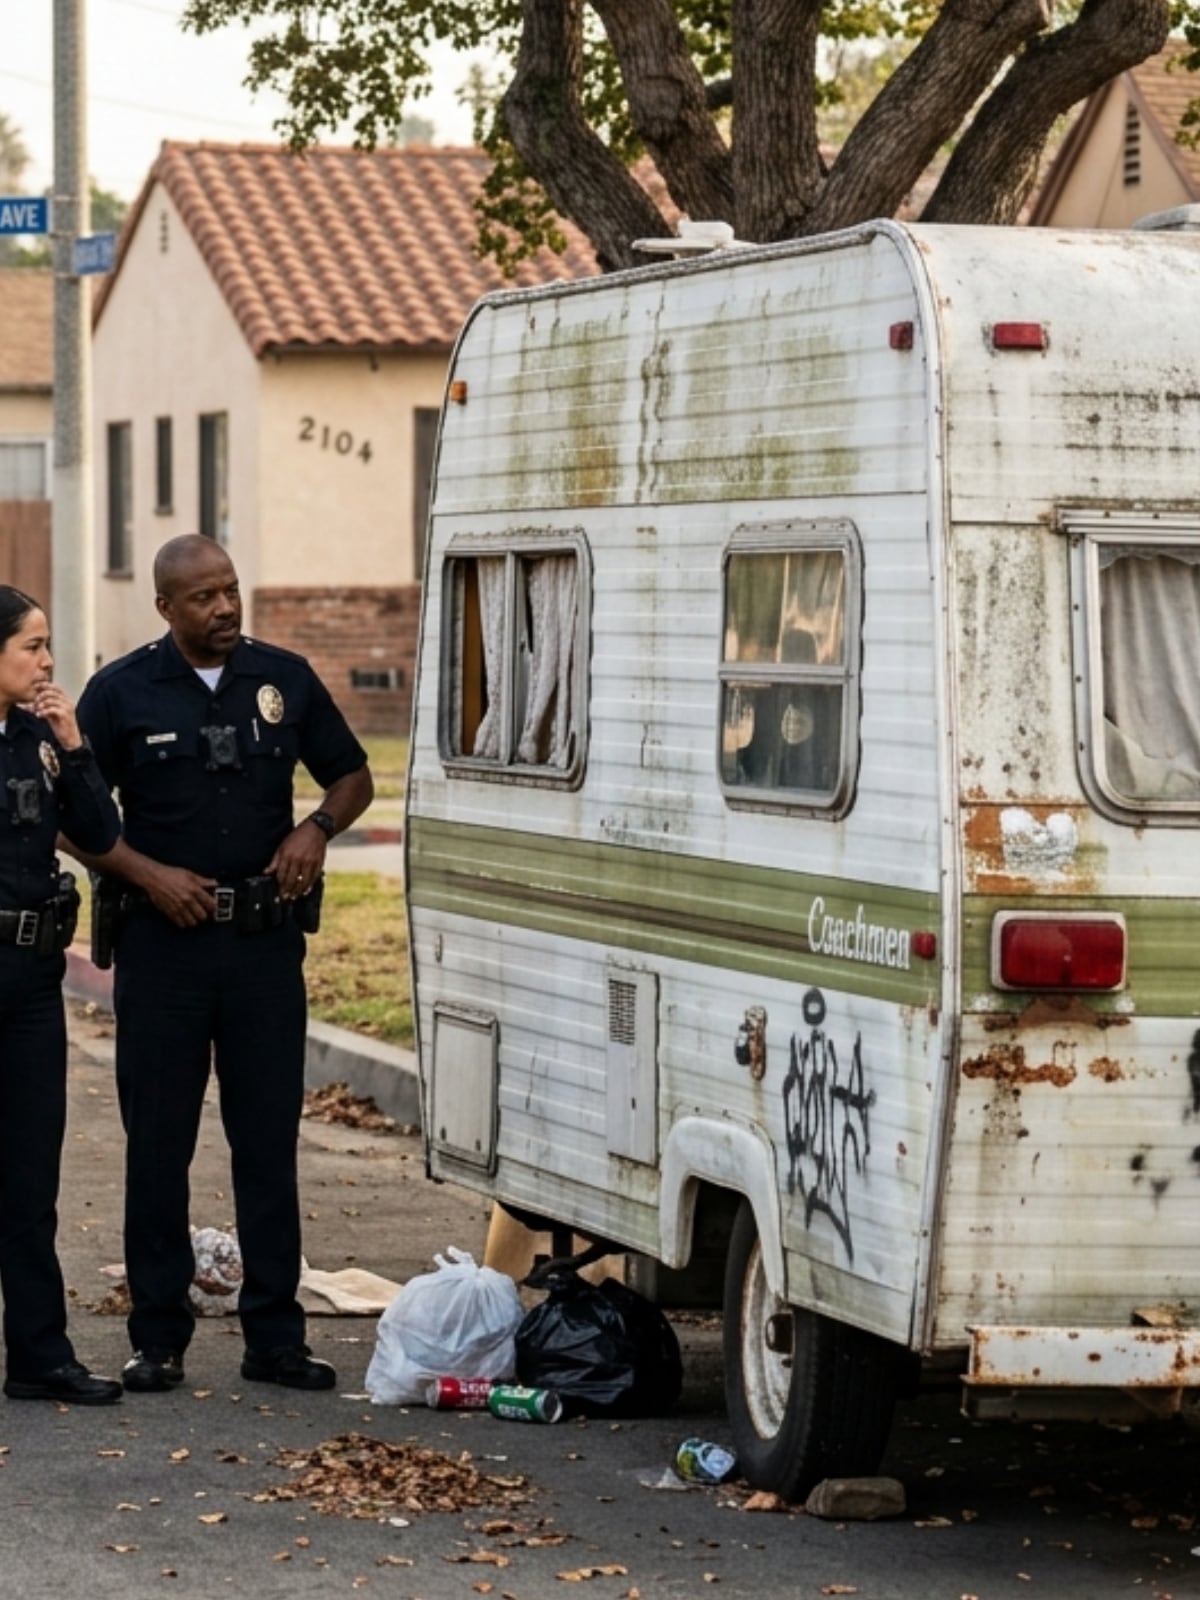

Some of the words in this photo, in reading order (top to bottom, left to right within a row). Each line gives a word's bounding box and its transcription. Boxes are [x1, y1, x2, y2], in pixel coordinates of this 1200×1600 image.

[0, 203, 39, 228] AVE
[298, 416, 373, 465] 2104
[808, 896, 910, 970] Coachmen
